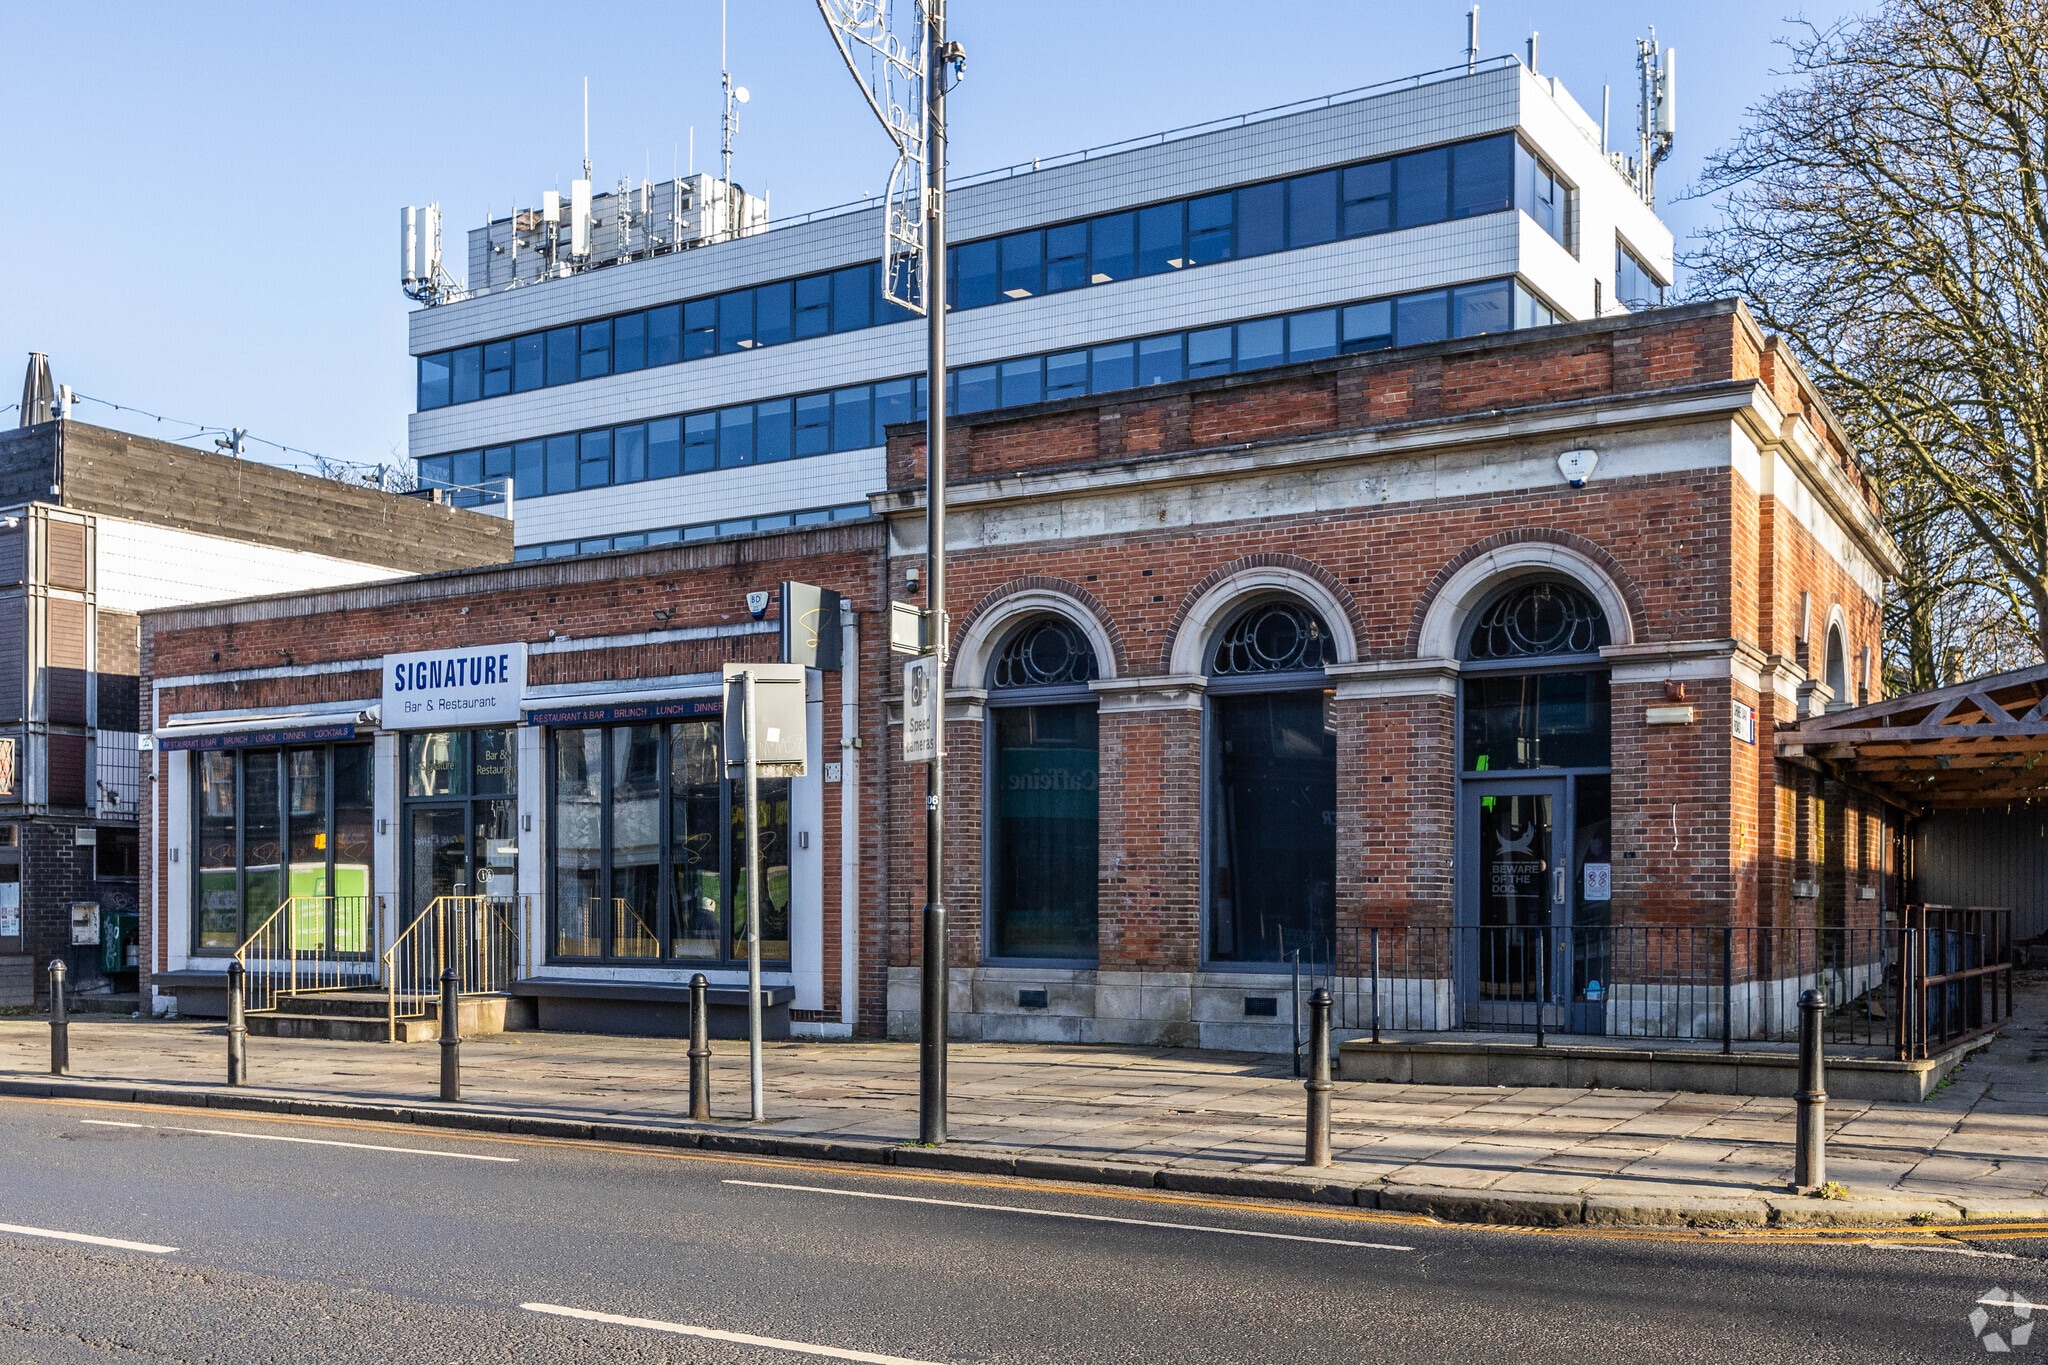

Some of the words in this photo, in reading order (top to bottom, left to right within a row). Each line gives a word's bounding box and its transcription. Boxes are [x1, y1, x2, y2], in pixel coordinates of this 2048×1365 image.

[394, 654, 509, 692] SIGNATURE
[404, 701, 422, 713] Bar
[426, 699, 434, 711] &
[438, 696, 496, 710] Restaurant
[533, 712, 581, 723] RESTAURANT
[588, 710, 605, 719] BAR
[614, 708, 647, 718] BRUNCH
[656, 705, 684, 715] LUNCH
[694, 701, 724, 712] DINNER
[909, 714, 931, 734] Speed
[163, 739, 200, 750] RESTAURANT
[204, 738, 217, 747] BAR
[223, 735, 248, 744] BRUNCH
[255, 733, 276, 743] LUNCH
[282, 731, 307, 740] DINNER
[314, 727, 348, 738] COCKTAILS
[906, 738, 934, 753] cameras
[485, 750, 499, 761] Bar
[1492, 865, 1540, 874] BEWARE
[1492, 875, 1507, 884] OF
[1508, 875, 1531, 884] THE
